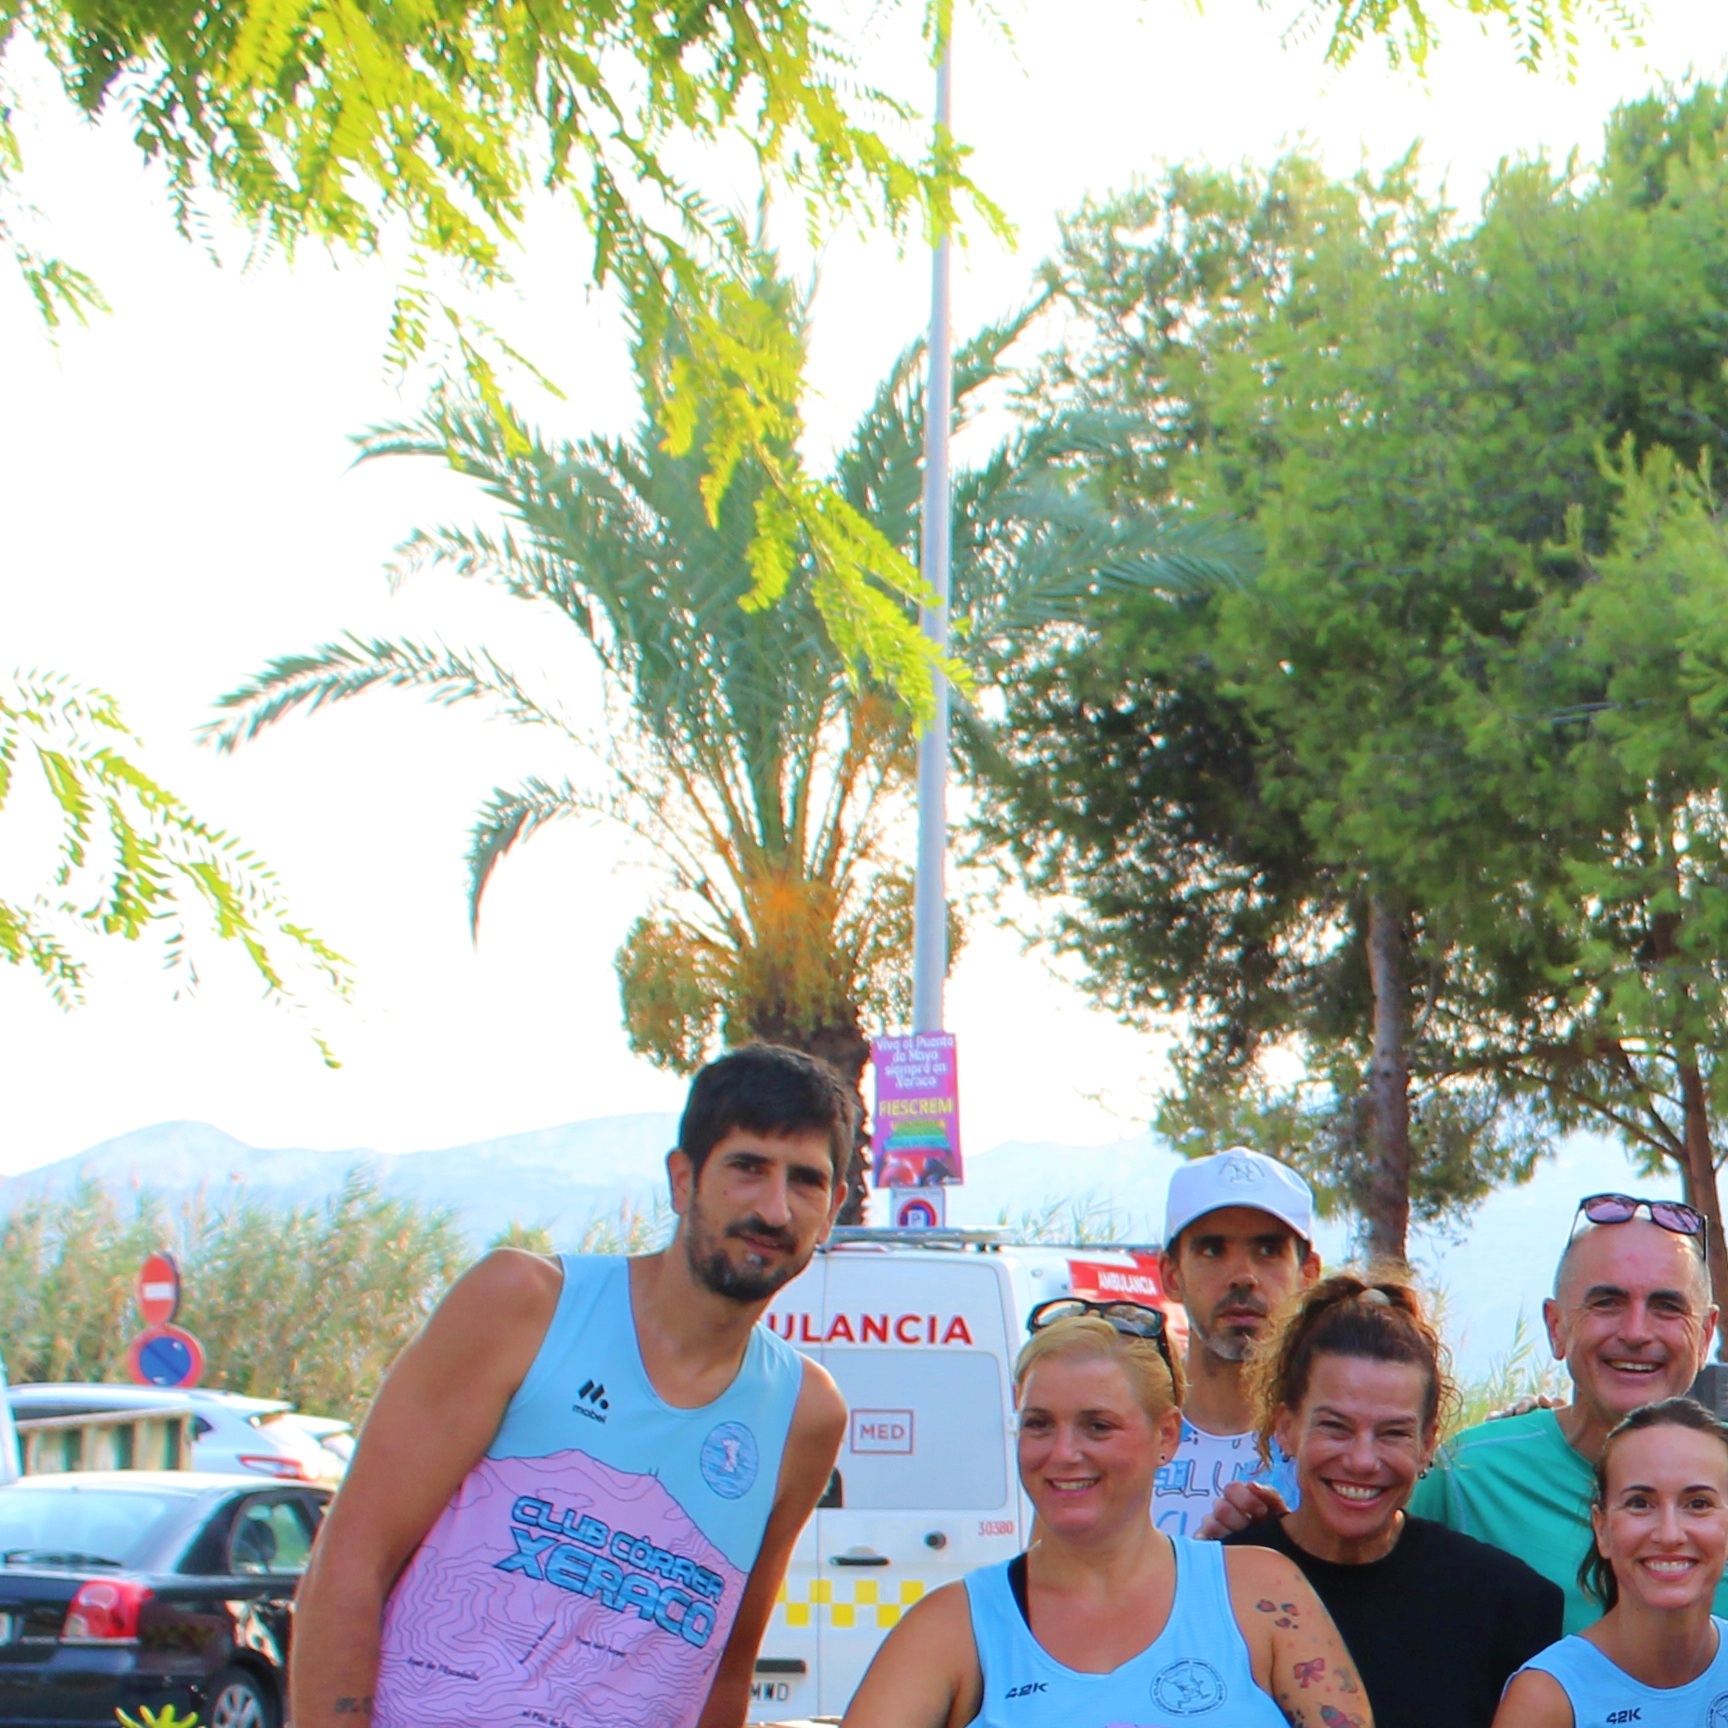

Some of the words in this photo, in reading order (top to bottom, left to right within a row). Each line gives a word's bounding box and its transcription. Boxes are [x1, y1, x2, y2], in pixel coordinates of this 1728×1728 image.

[1098, 1271, 1158, 1295] AMBULANCIA
[768, 1313, 973, 1345] ULANCIA
[860, 1423, 905, 1439] MED
[511, 1495, 609, 1549] CLUB
[494, 1526, 717, 1649] XERACO
[1606, 1707, 1642, 1725] 42K
